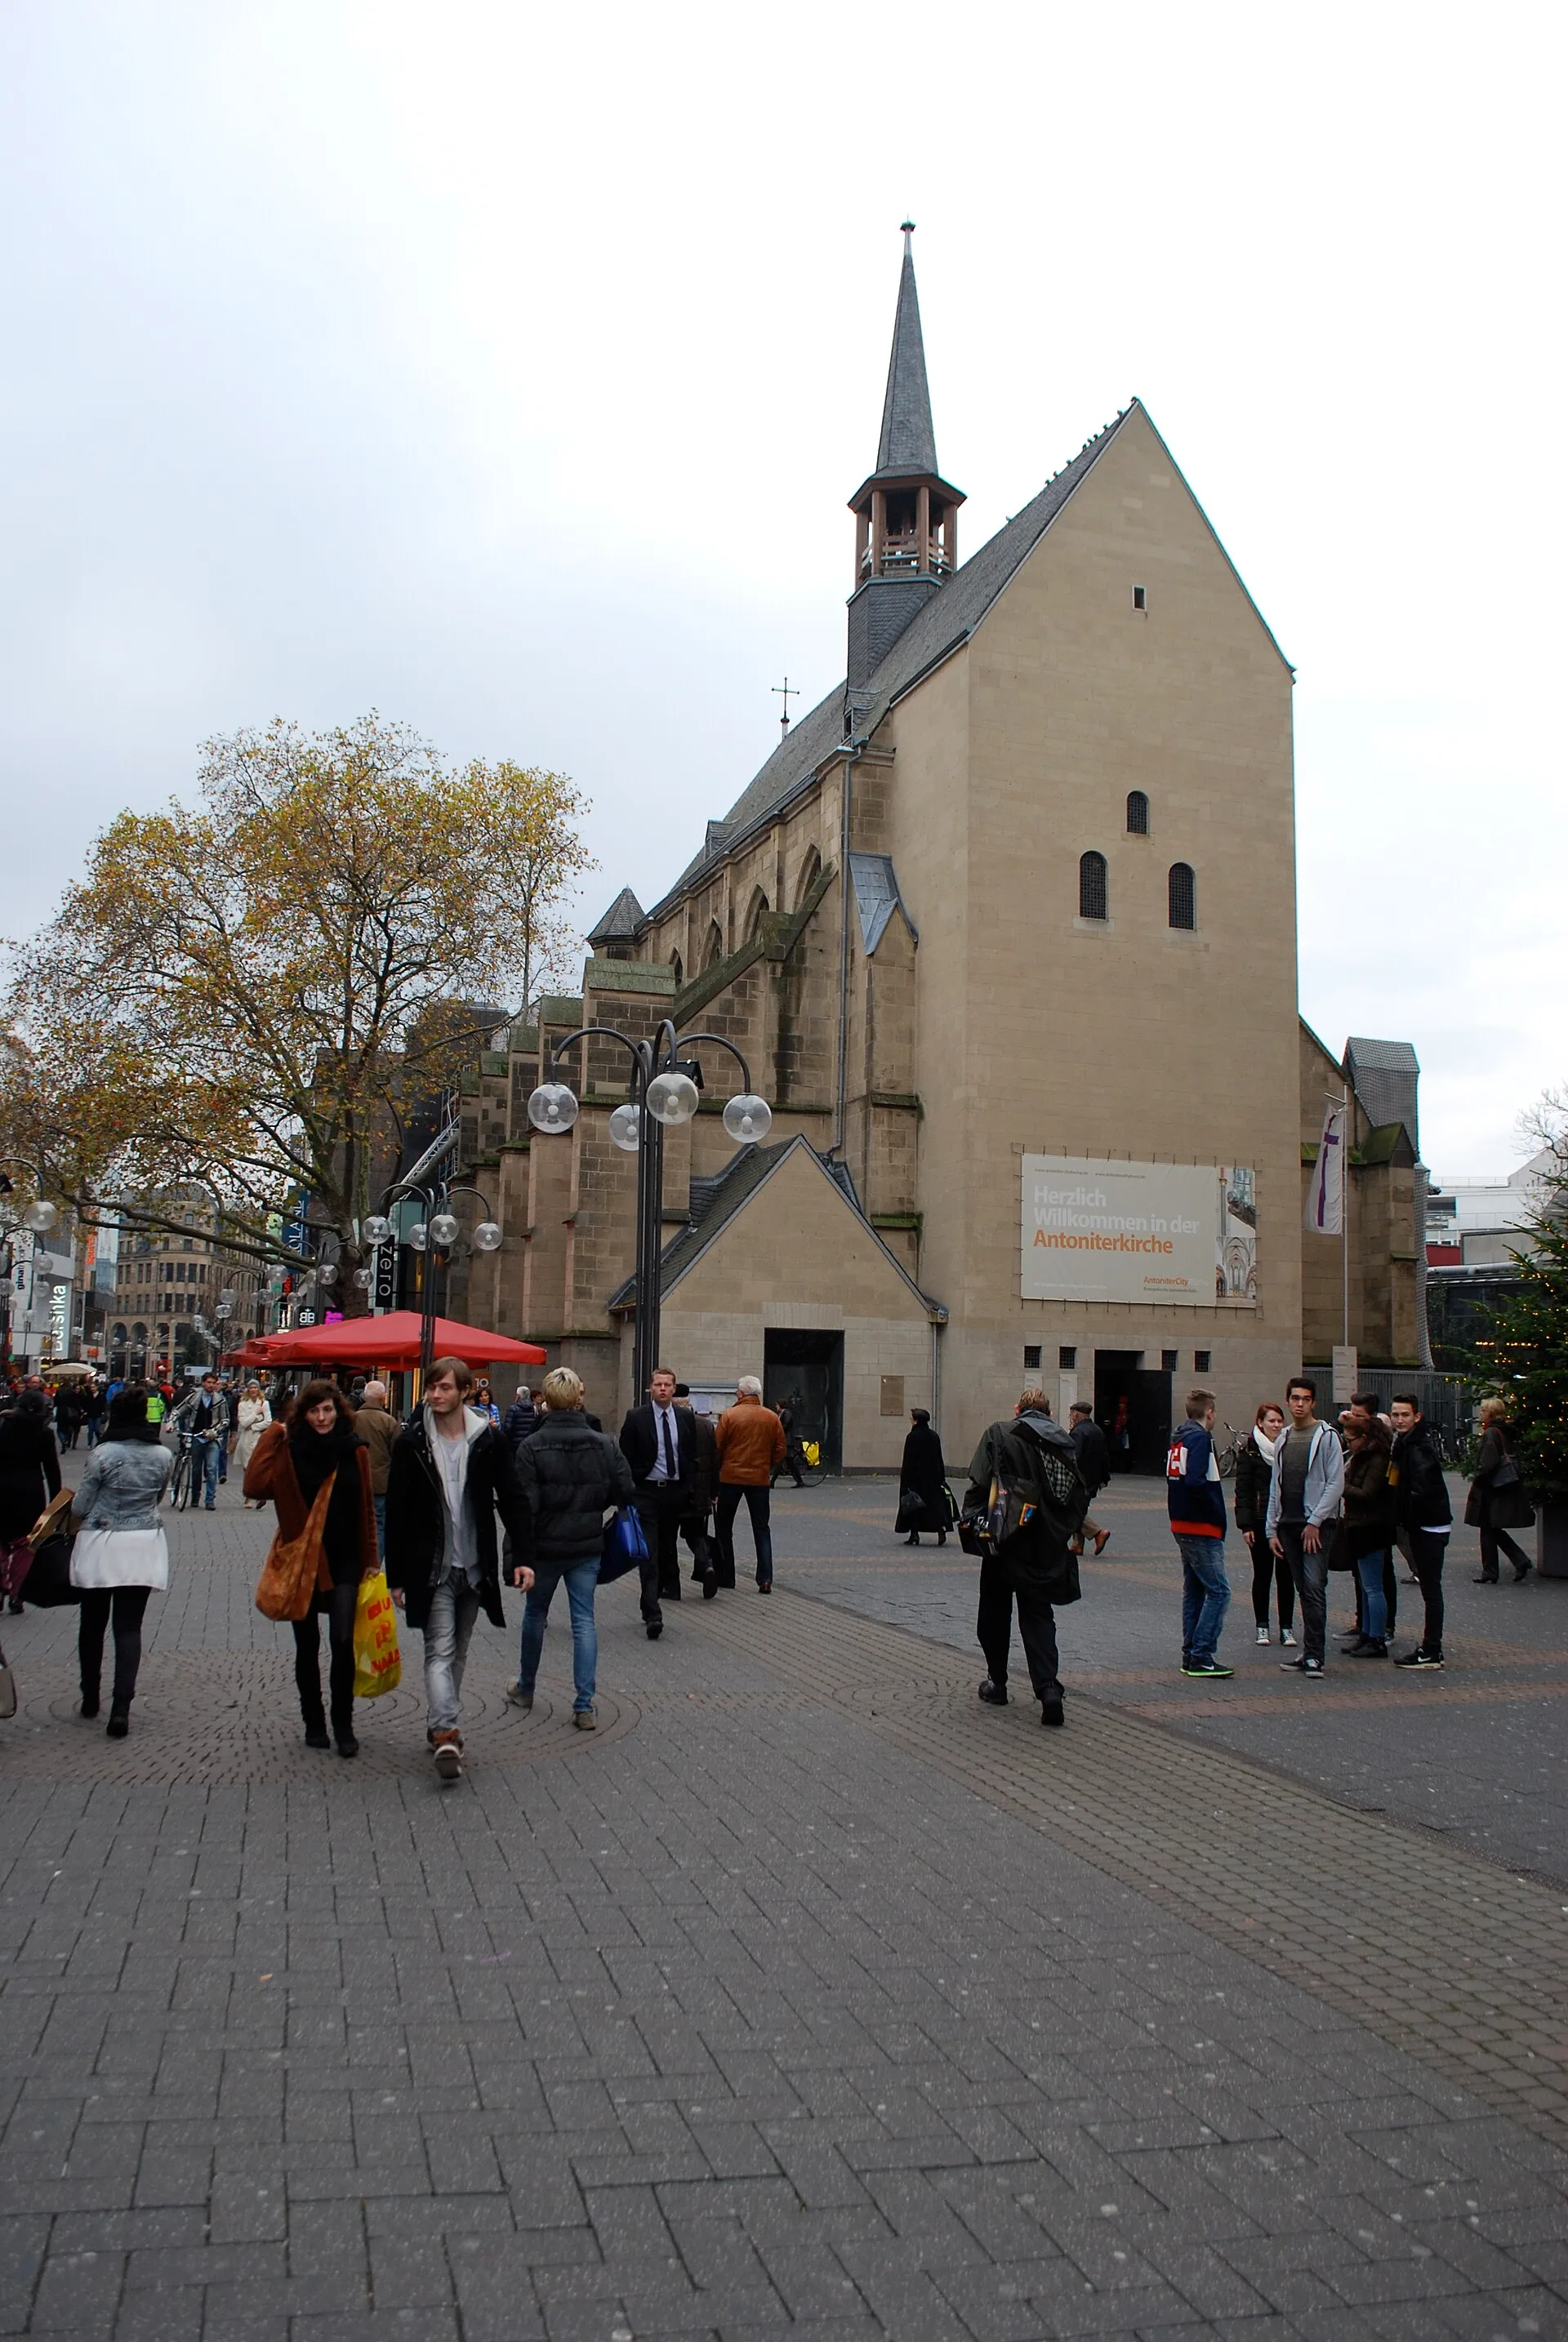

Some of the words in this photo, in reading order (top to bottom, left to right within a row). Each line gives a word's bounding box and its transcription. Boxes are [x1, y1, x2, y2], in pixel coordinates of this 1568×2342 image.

[1034, 1186, 1107, 1208] Herzlich
[287, 1200, 303, 1255] OLAND
[1034, 1207, 1147, 1231] Willkommen
[1151, 1213, 1167, 1232] in
[1170, 1214, 1200, 1234] der
[1033, 1229, 1174, 1254] Antoniterkirche
[16, 1249, 25, 1291] ginatrco
[378, 1244, 392, 1297] zero
